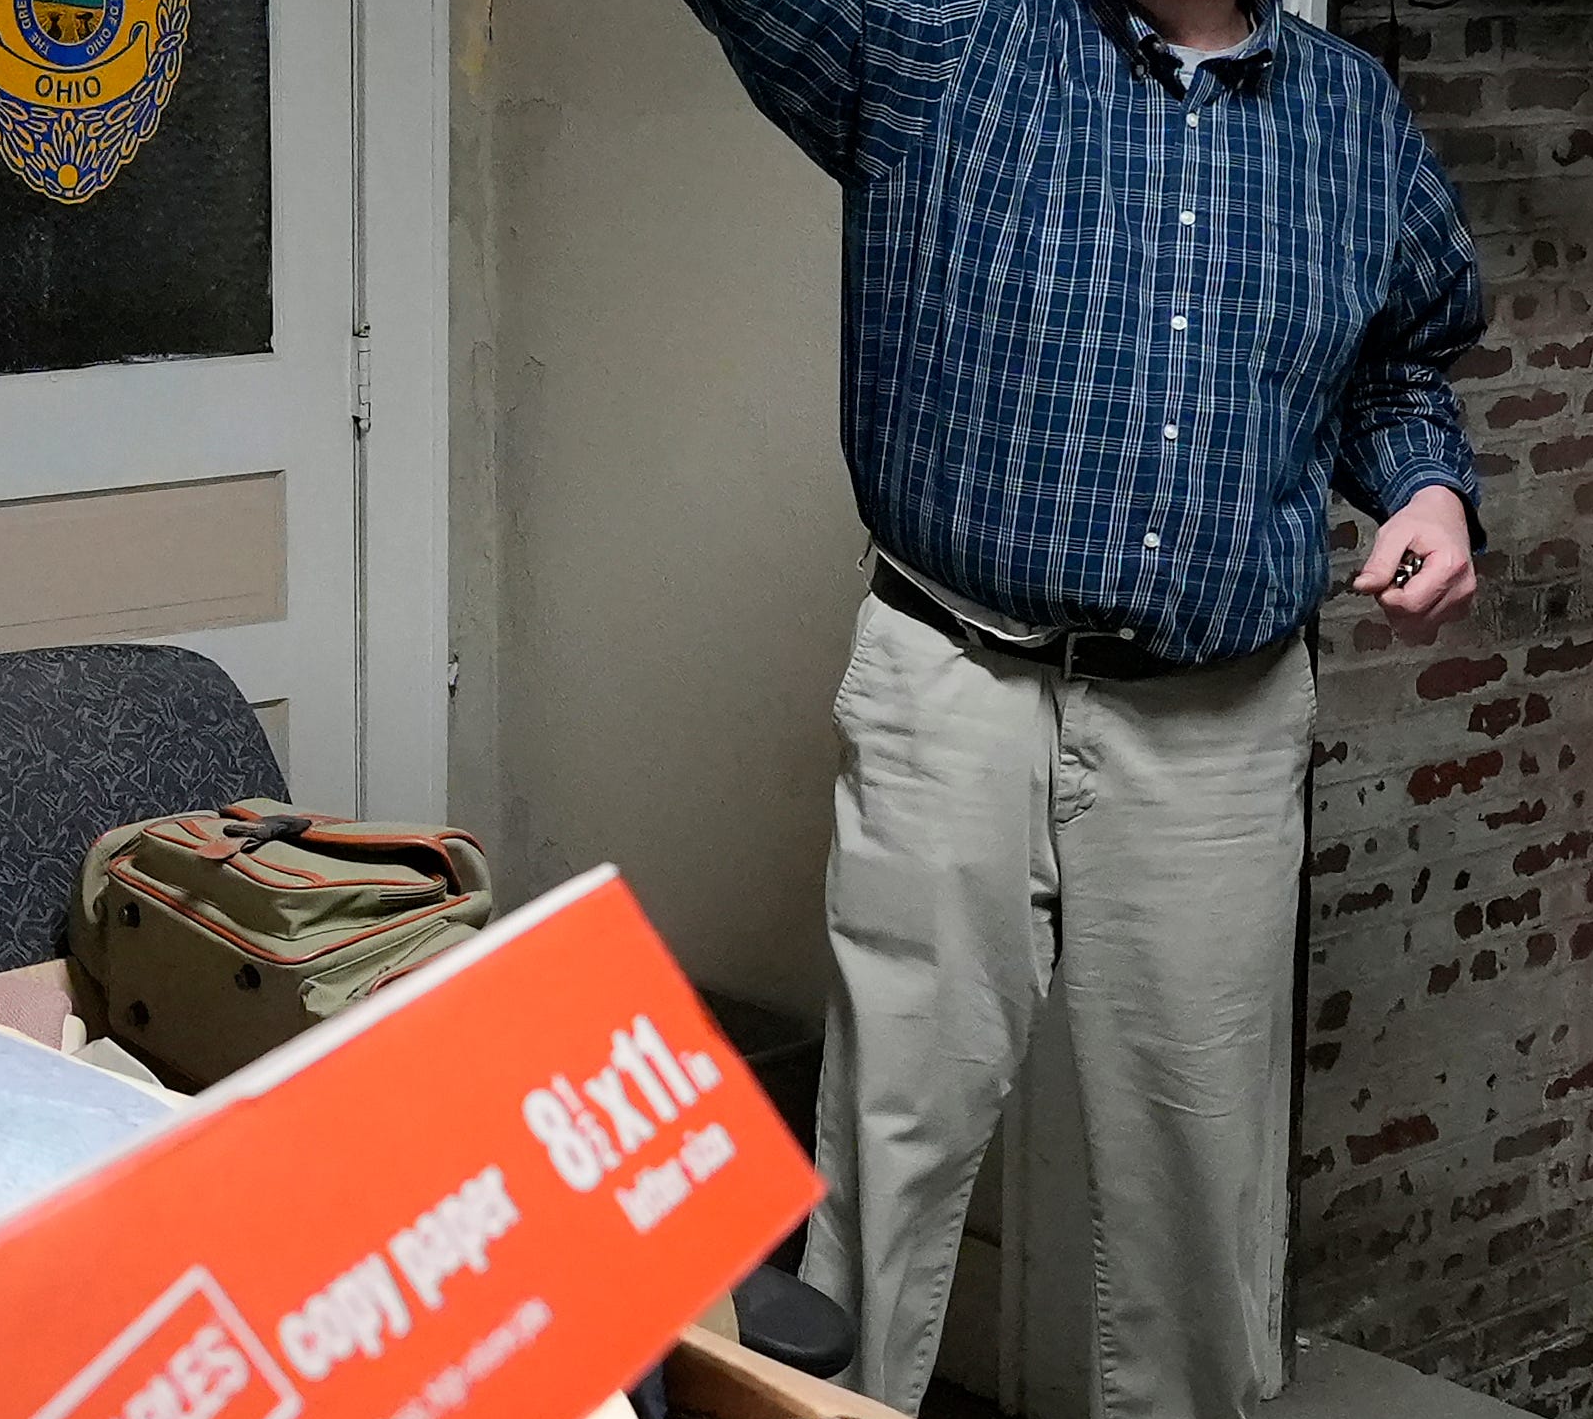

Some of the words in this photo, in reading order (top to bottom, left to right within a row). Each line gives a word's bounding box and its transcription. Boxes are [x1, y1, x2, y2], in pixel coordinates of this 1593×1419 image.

[109, 6, 120, 27] OF
[28, 32, 51, 56] THE
[86, 27, 112, 56] OHIO
[35, 74, 102, 104] OHIO
[276, 1251, 411, 1382] copy
[386, 1164, 522, 1311] paper
